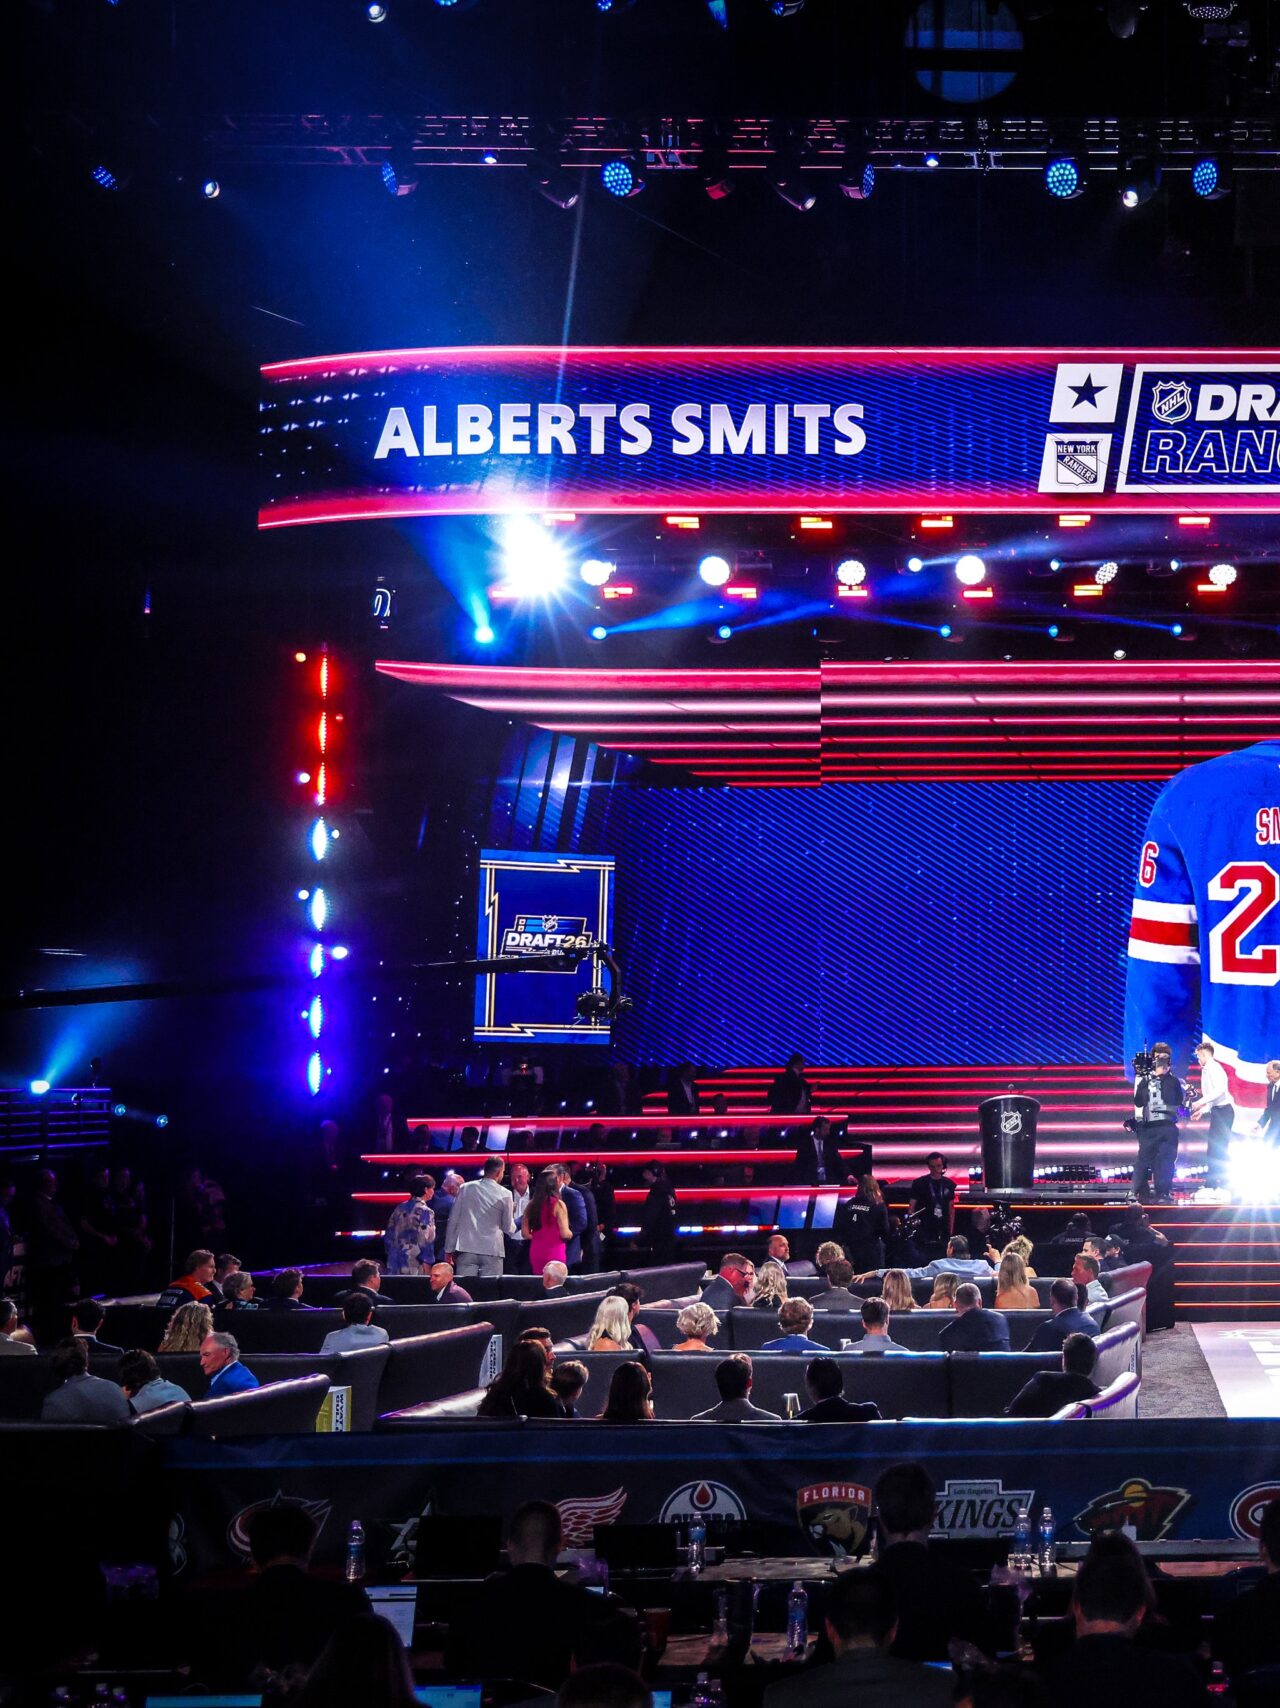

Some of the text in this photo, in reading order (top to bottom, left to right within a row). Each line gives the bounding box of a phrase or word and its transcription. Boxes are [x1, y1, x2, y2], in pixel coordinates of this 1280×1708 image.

[1161, 393, 1184, 414] NHL
[374, 403, 867, 459] ALBERTS SMITS
[1057, 444, 1096, 453] NEW YORK
[1063, 456, 1096, 481] RANGERS
[506, 932, 587, 948] DRAFT 26
[932, 1499, 1023, 1529] KINGS
